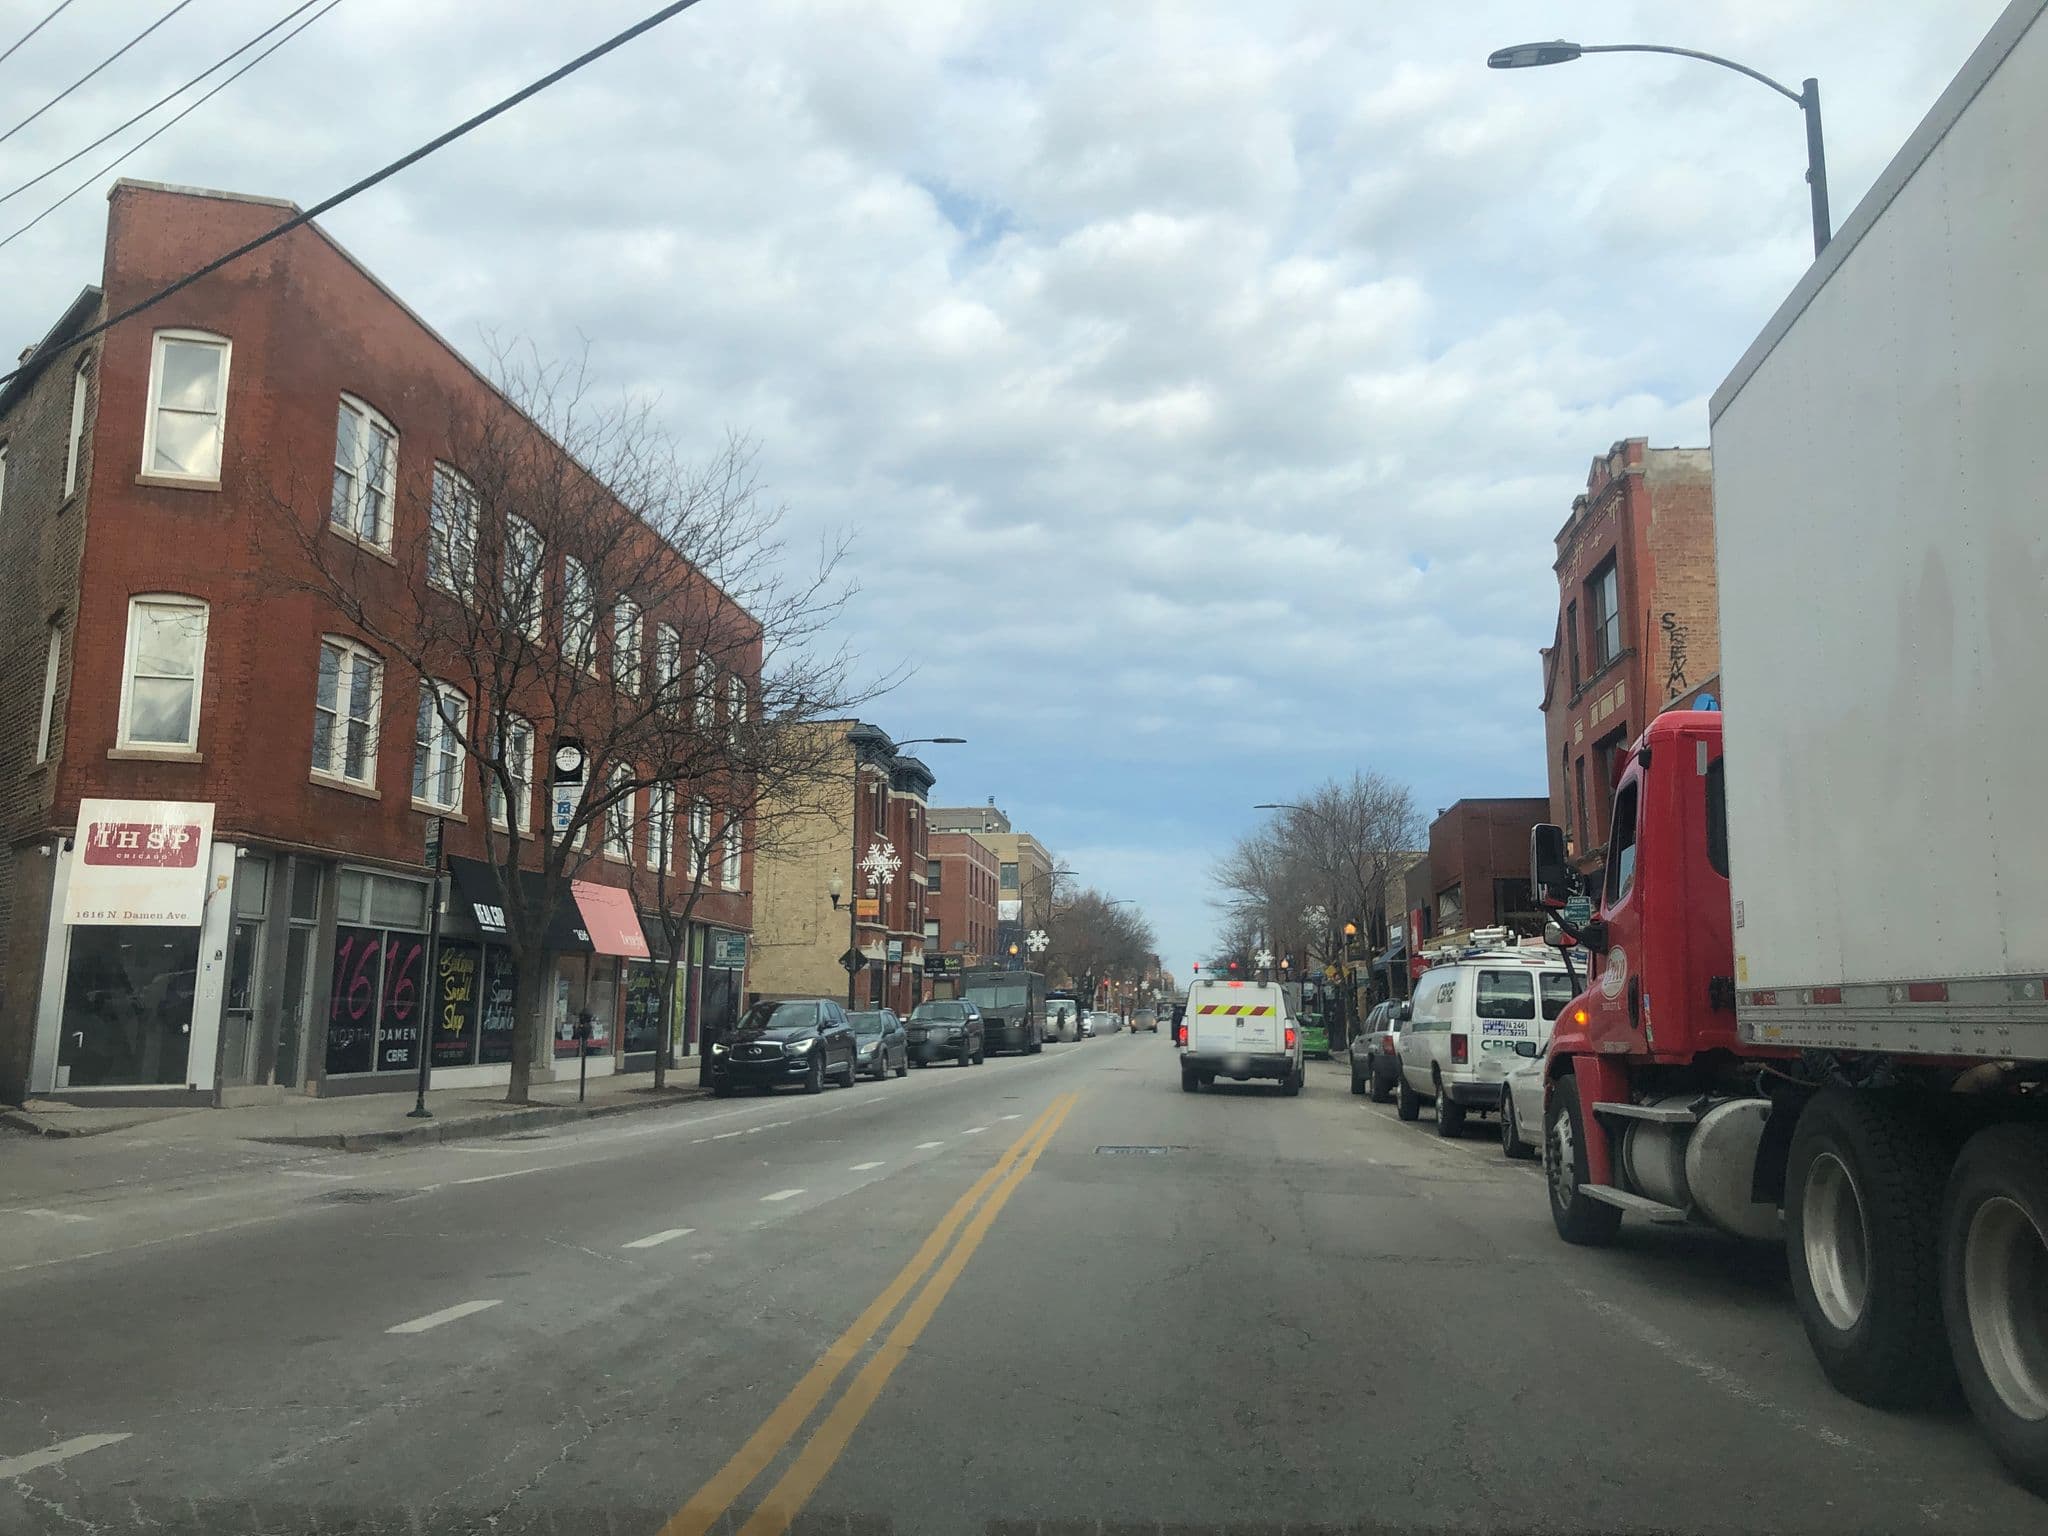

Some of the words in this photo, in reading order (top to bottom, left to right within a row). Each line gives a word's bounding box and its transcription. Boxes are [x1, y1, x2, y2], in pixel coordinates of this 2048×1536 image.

[116, 853, 168, 861] CHICAGO
[76, 911, 104, 919] 1616
[123, 911, 163, 920] Damen
[380, 1028, 417, 1041] DAMEN
[386, 1048, 408, 1062] CBRE
